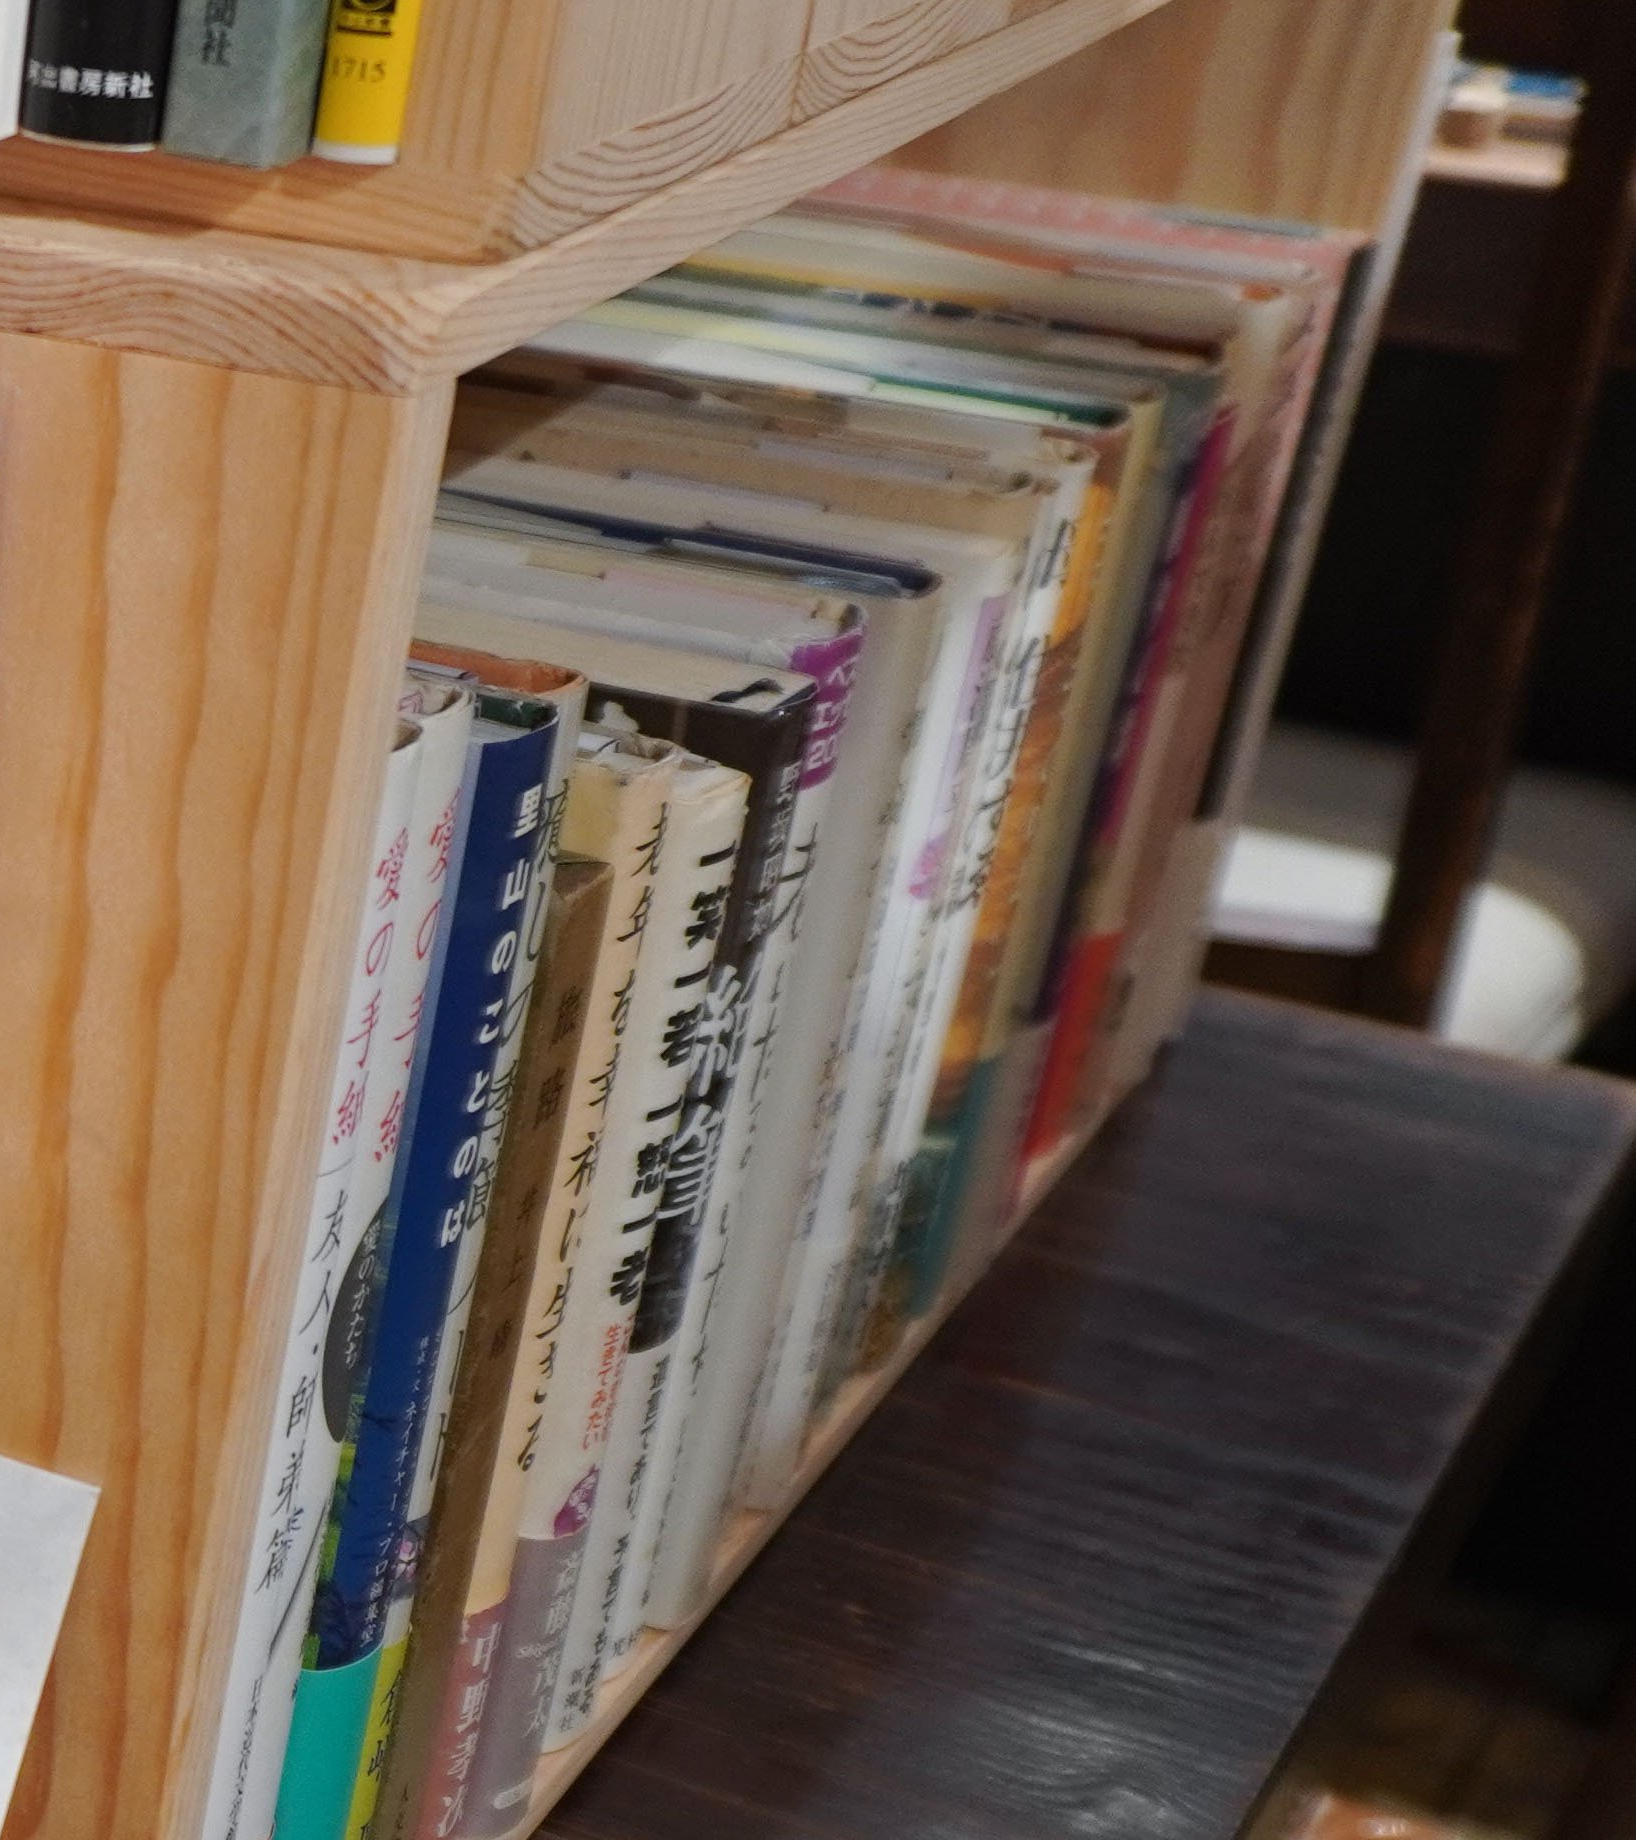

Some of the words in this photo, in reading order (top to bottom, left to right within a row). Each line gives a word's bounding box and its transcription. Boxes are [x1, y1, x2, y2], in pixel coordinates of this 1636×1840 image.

[439, 783, 544, 1248] 里山のことのは
